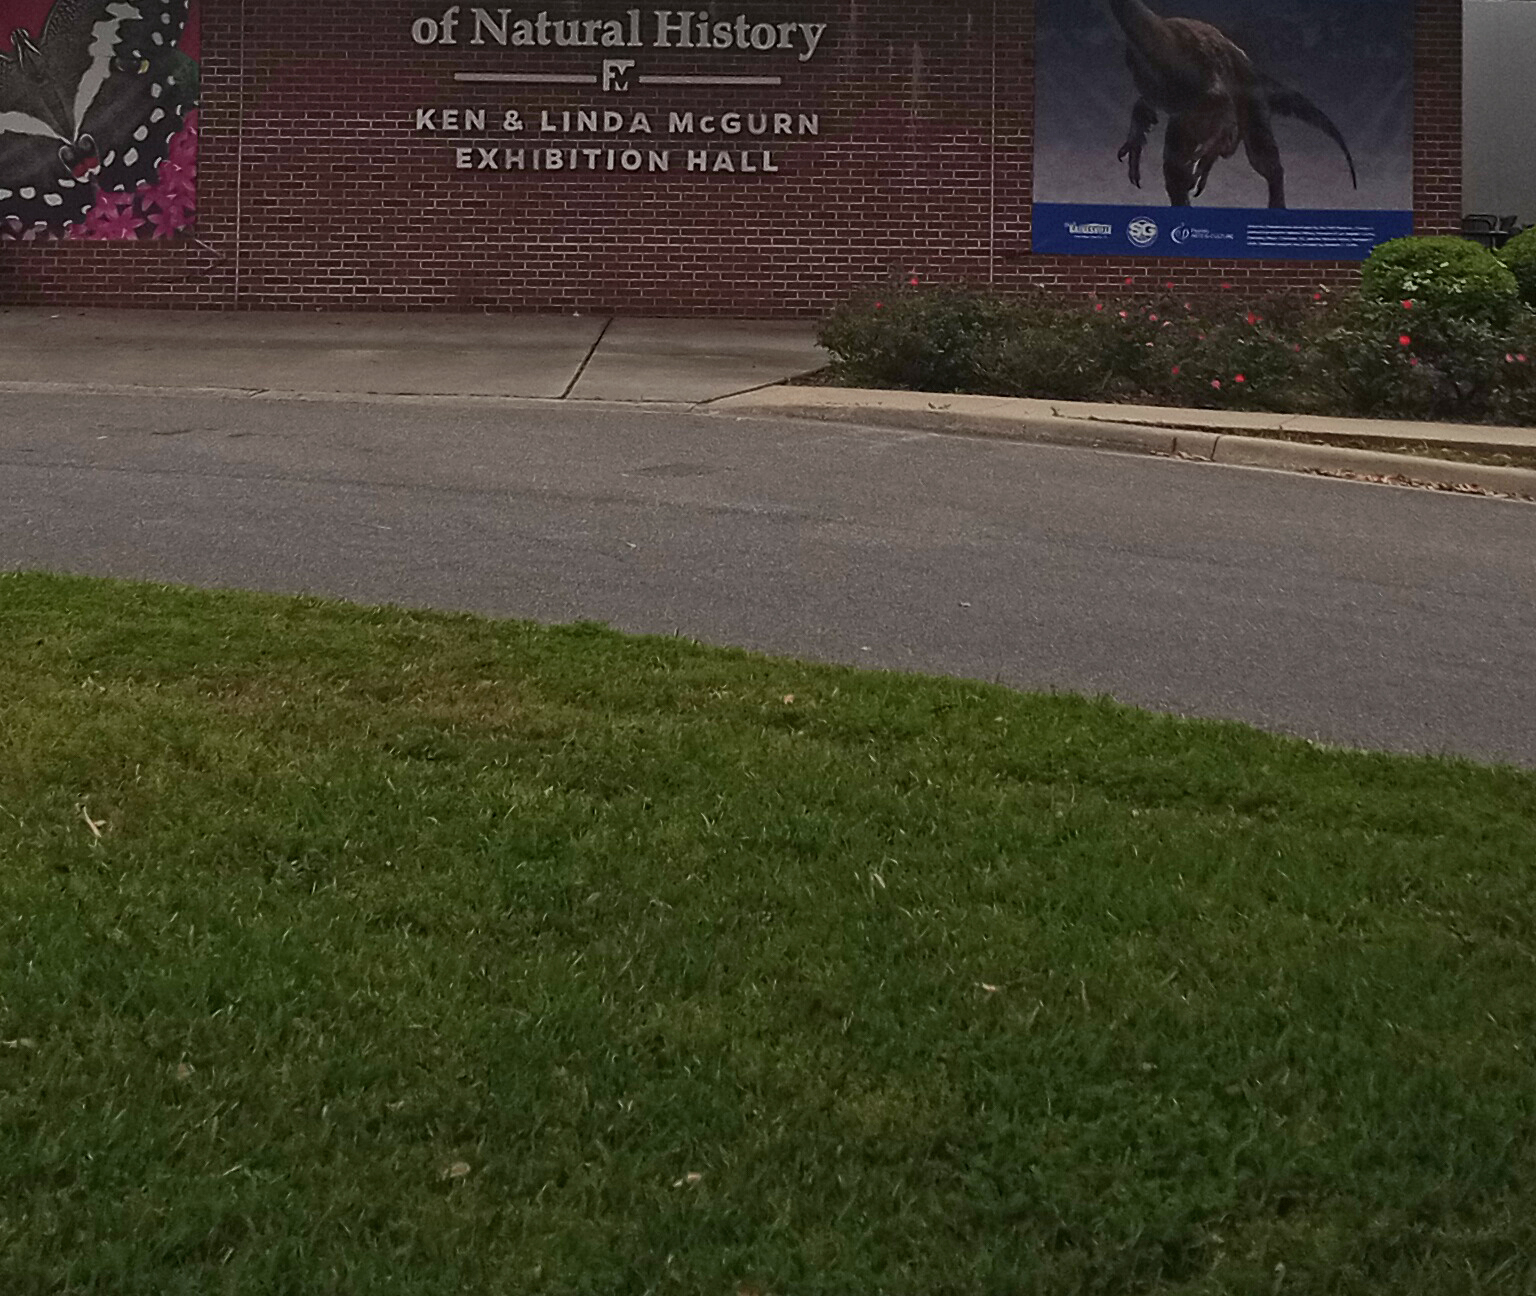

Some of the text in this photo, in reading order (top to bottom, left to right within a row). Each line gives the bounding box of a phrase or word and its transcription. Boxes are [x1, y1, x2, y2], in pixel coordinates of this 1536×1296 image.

[411, 5, 827, 62] of Natural History
[416, 108, 819, 135] KEN & LINDA McGURN
[456, 147, 779, 173] EXHIBITION HALL
